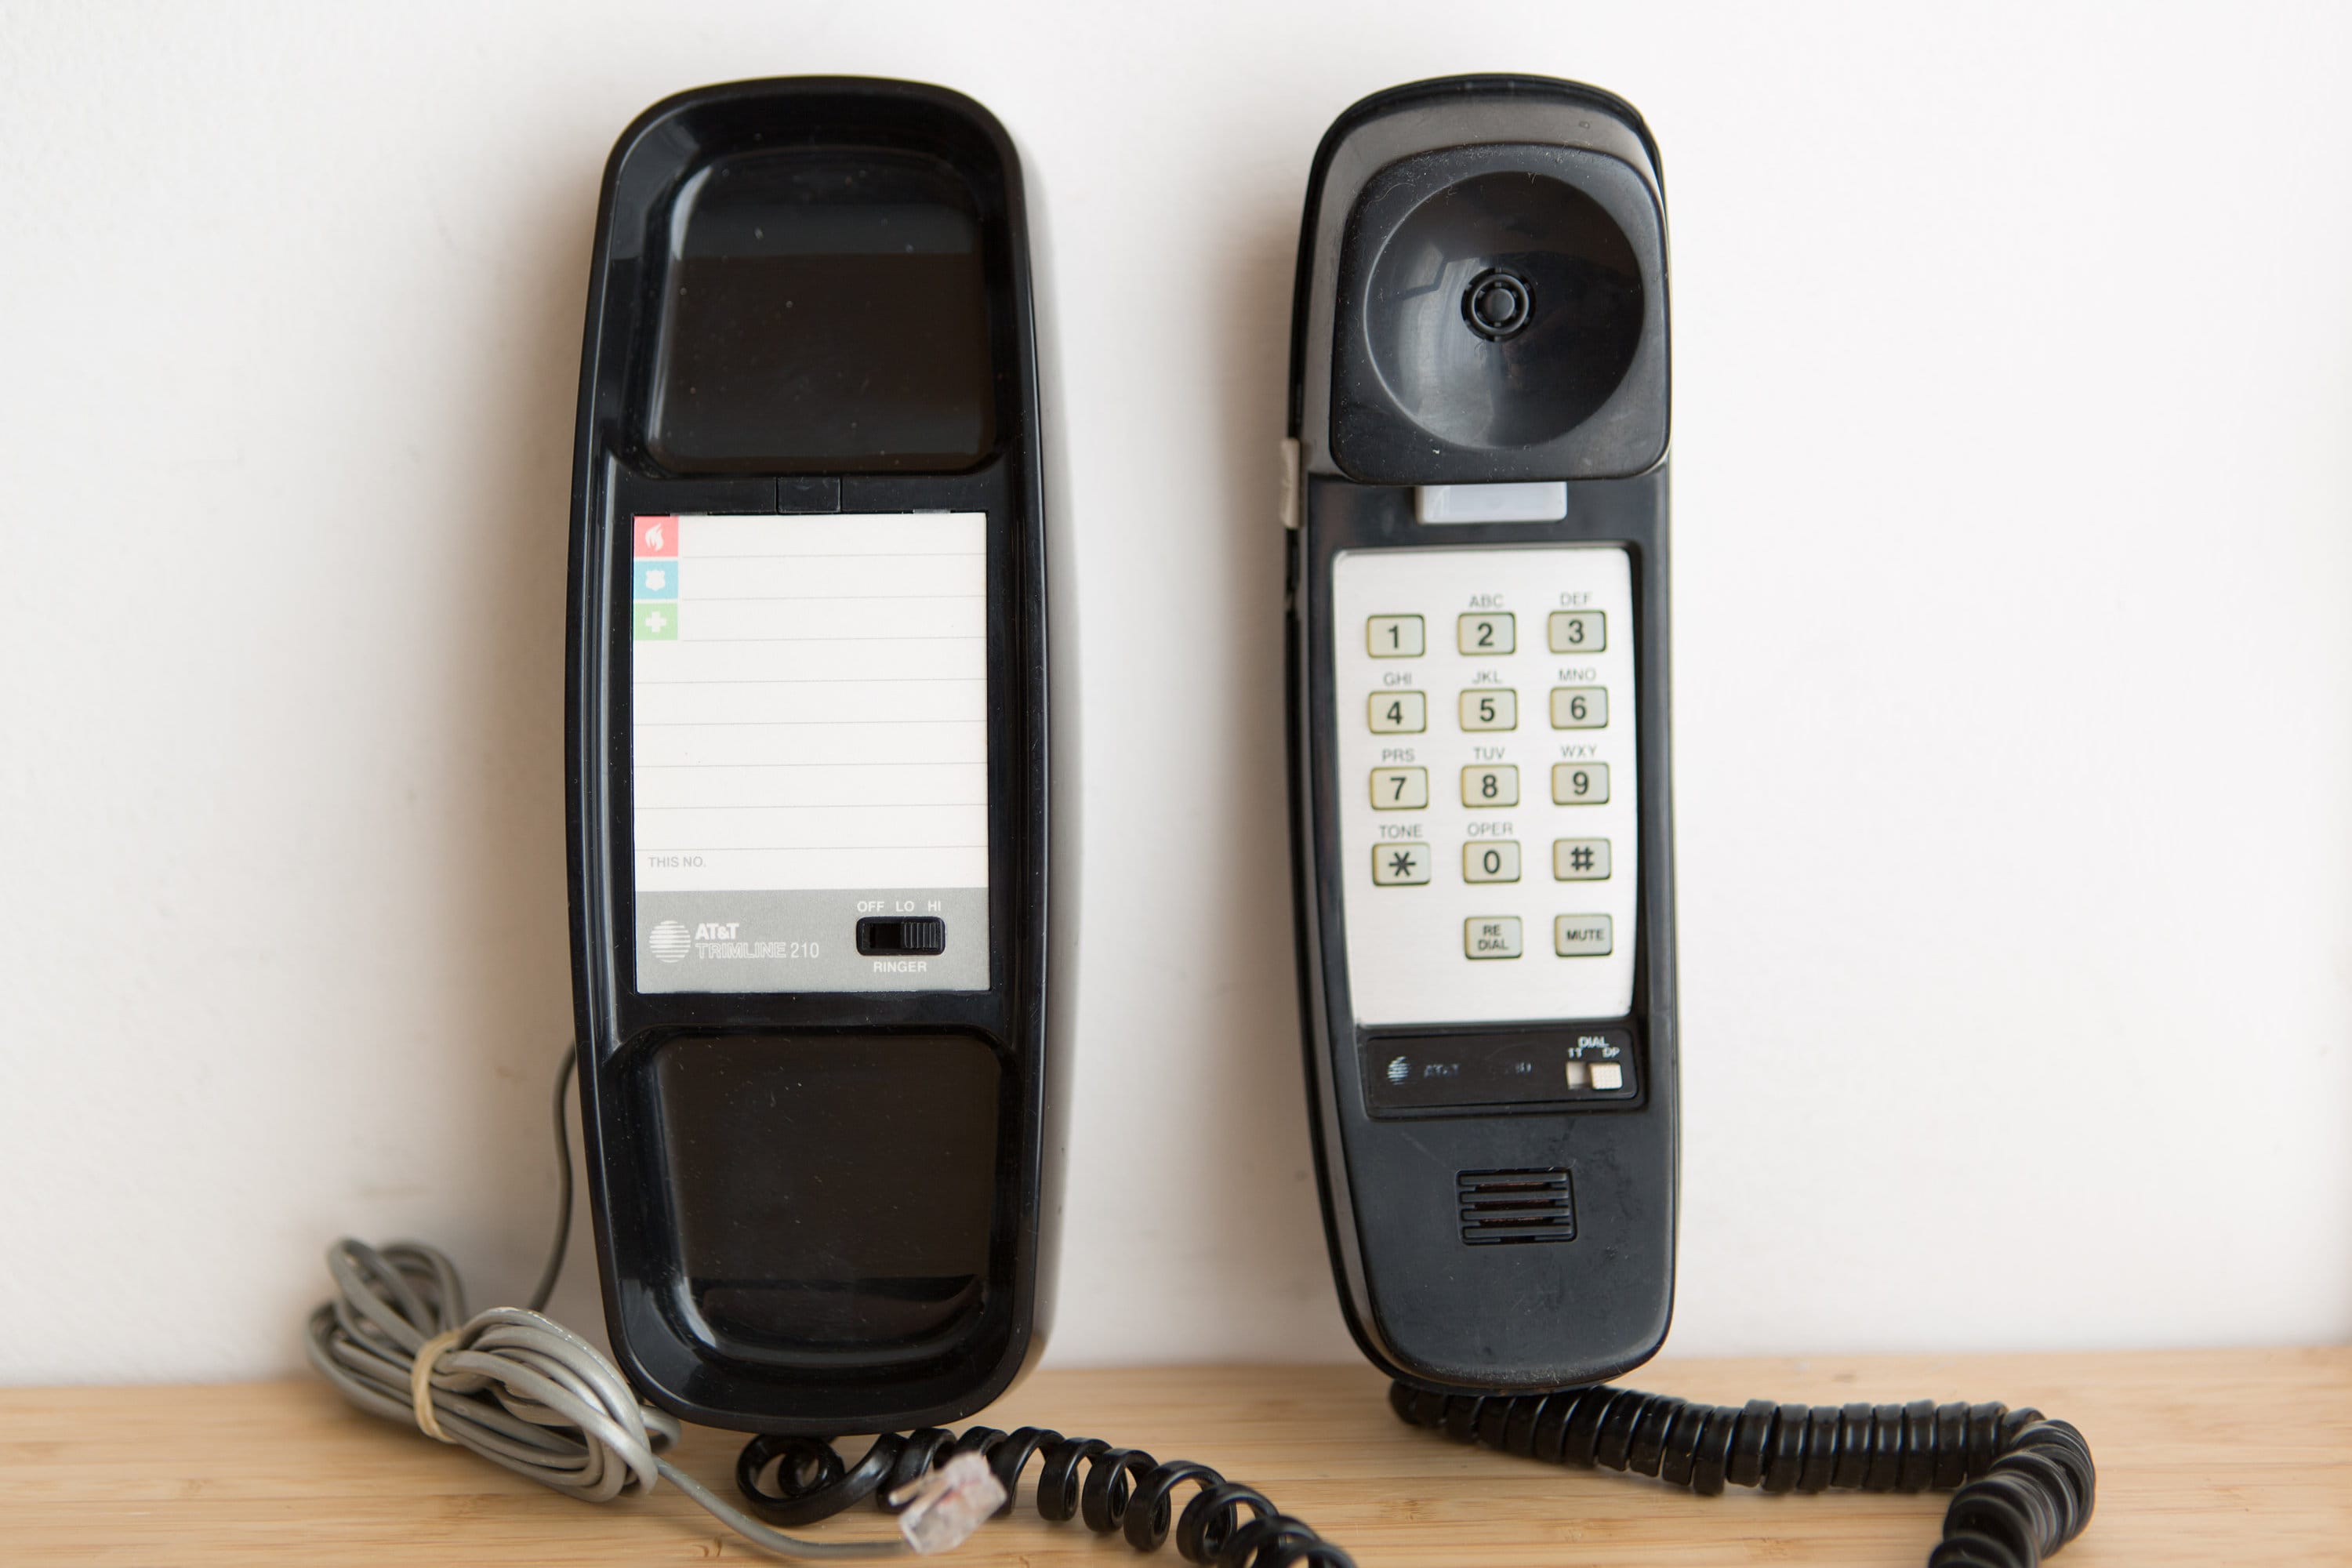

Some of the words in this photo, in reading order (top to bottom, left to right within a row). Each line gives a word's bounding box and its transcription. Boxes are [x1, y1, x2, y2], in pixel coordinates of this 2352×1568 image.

[1469, 595, 1504, 608] ABC
[1560, 593, 1592, 605] DEF
[1388, 625, 1399, 648] 1
[1478, 622, 1494, 647] 2
[1568, 619, 1584, 644] 3
[1383, 673, 1412, 686] GHI
[1472, 670, 1502, 684] JKL
[1559, 669, 1596, 681] MNO
[1387, 701, 1403, 725] 4
[1479, 698, 1495, 722] 5
[1570, 695, 1586, 720] 6
[1382, 749, 1415, 762] PRS
[1475, 747, 1505, 760] TUV
[1561, 745, 1598, 758] WXY
[1390, 776, 1406, 800] 7
[1482, 774, 1497, 798] 8
[1573, 771, 1589, 795] 9
[1380, 825, 1423, 838] TONE
[1468, 822, 1513, 837] OPER
[649, 857, 679, 868] THIS
[683, 856, 707, 868] NO.
[1483, 850, 1500, 874] 0
[857, 901, 884, 912] OFF
[895, 901, 914, 912] LO
[927, 901, 942, 912] HI
[695, 923, 739, 940] AT&T
[1483, 924, 1501, 936] RE
[1567, 929, 1605, 941] MUTE
[695, 942, 786, 959] TRIMLINE
[790, 942, 819, 958] 210
[1478, 938, 1509, 951] DIAL
[873, 961, 927, 973] RINGER
[1578, 1036, 1610, 1048] DIAL
